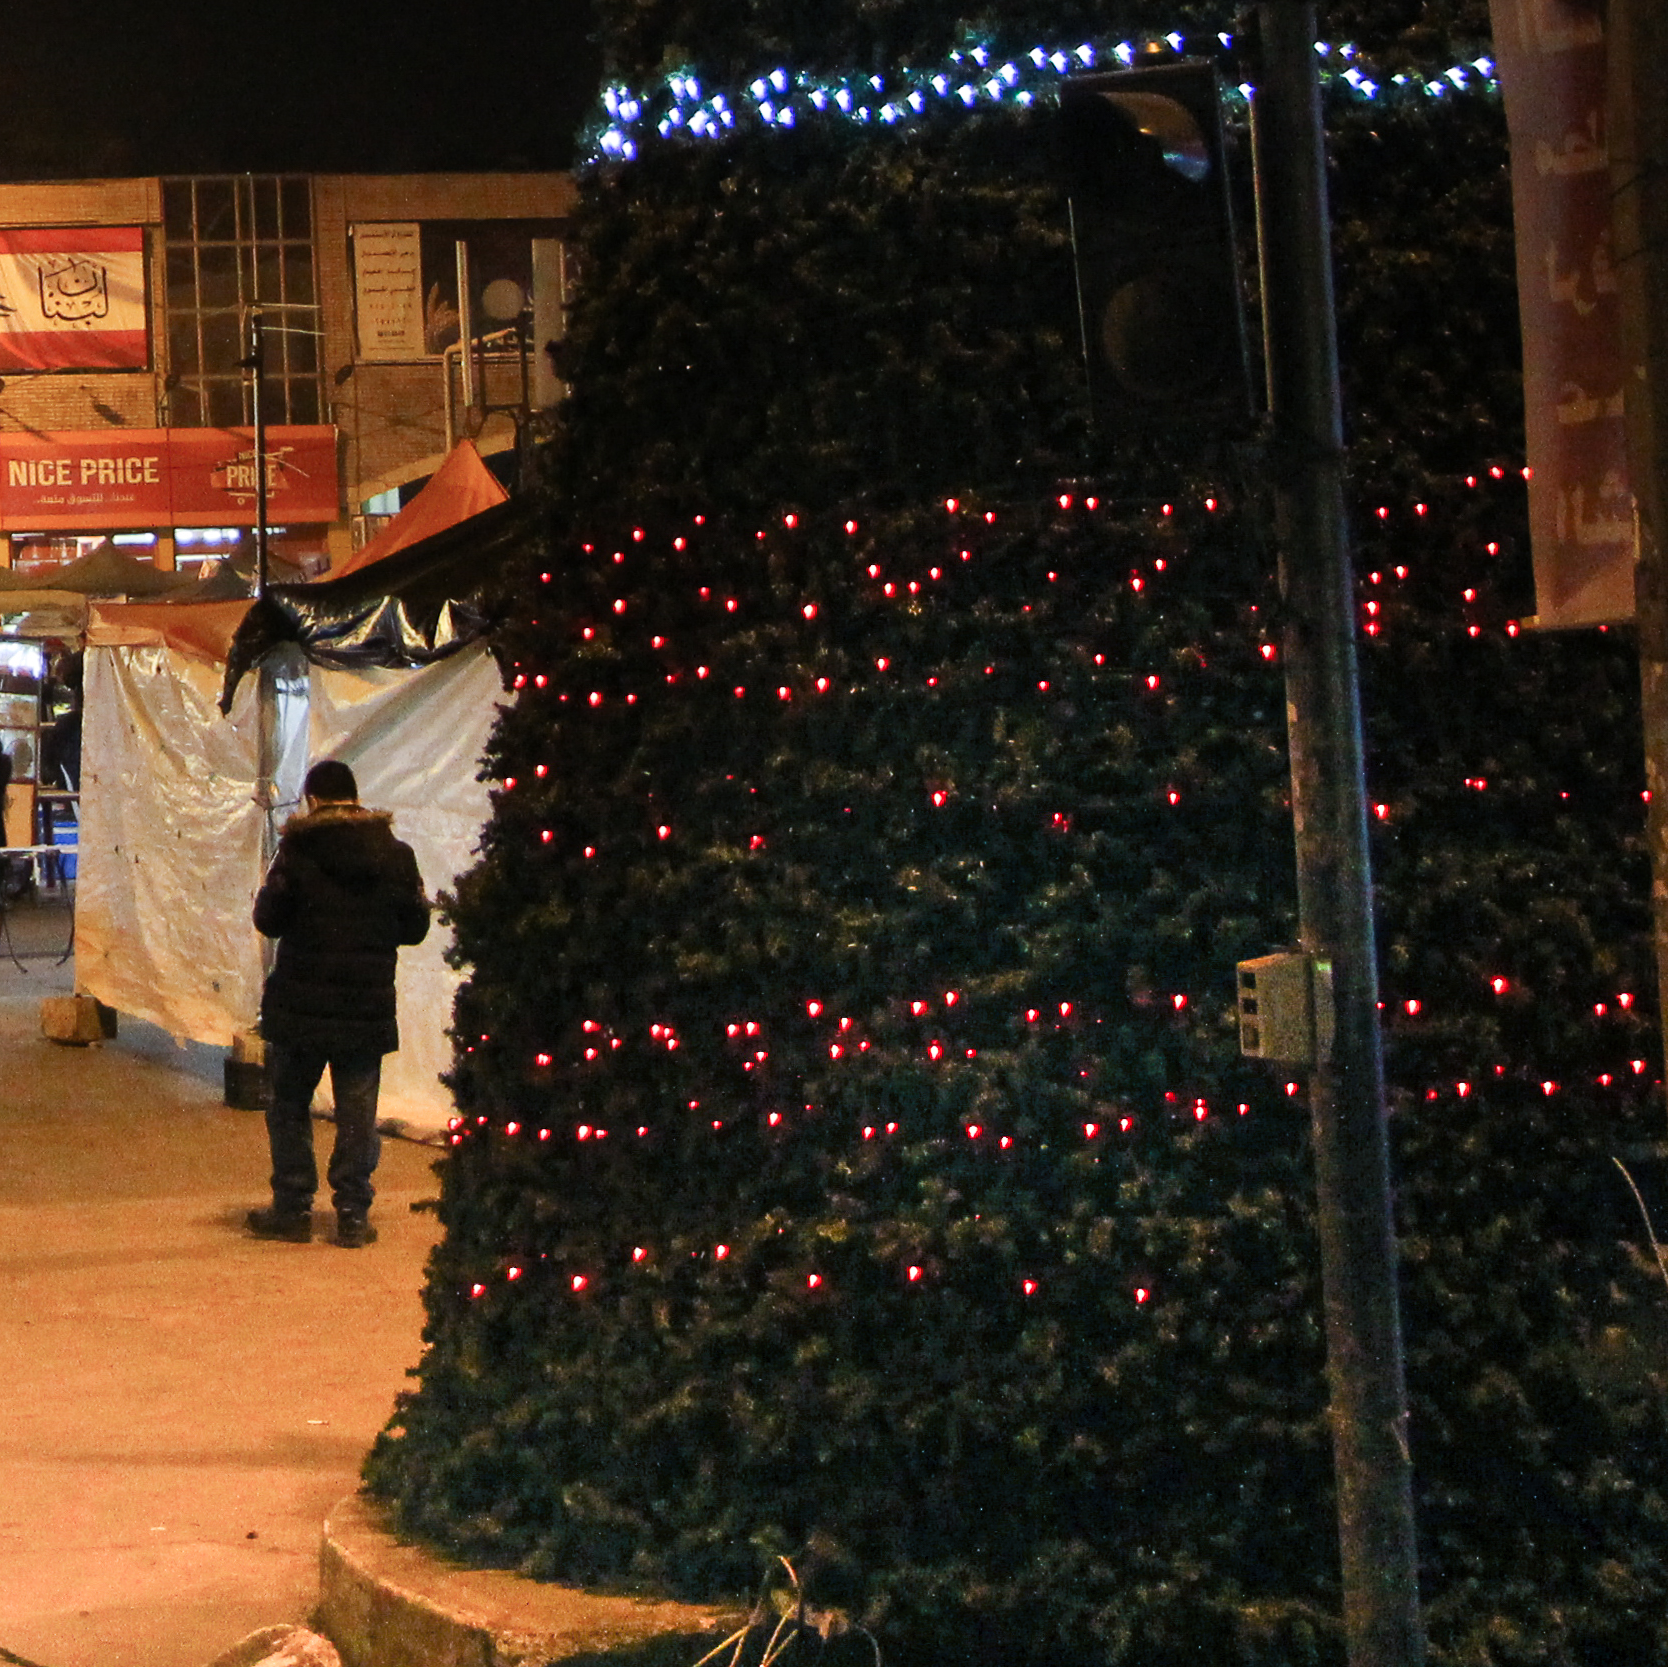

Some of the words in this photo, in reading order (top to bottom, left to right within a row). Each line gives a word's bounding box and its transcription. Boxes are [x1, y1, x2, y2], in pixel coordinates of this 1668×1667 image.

[37, 257, 109, 329] لبنان
[8, 459, 72, 487] NICE
[80, 456, 160, 485] PRICE
[226, 463, 278, 489] PRIE
